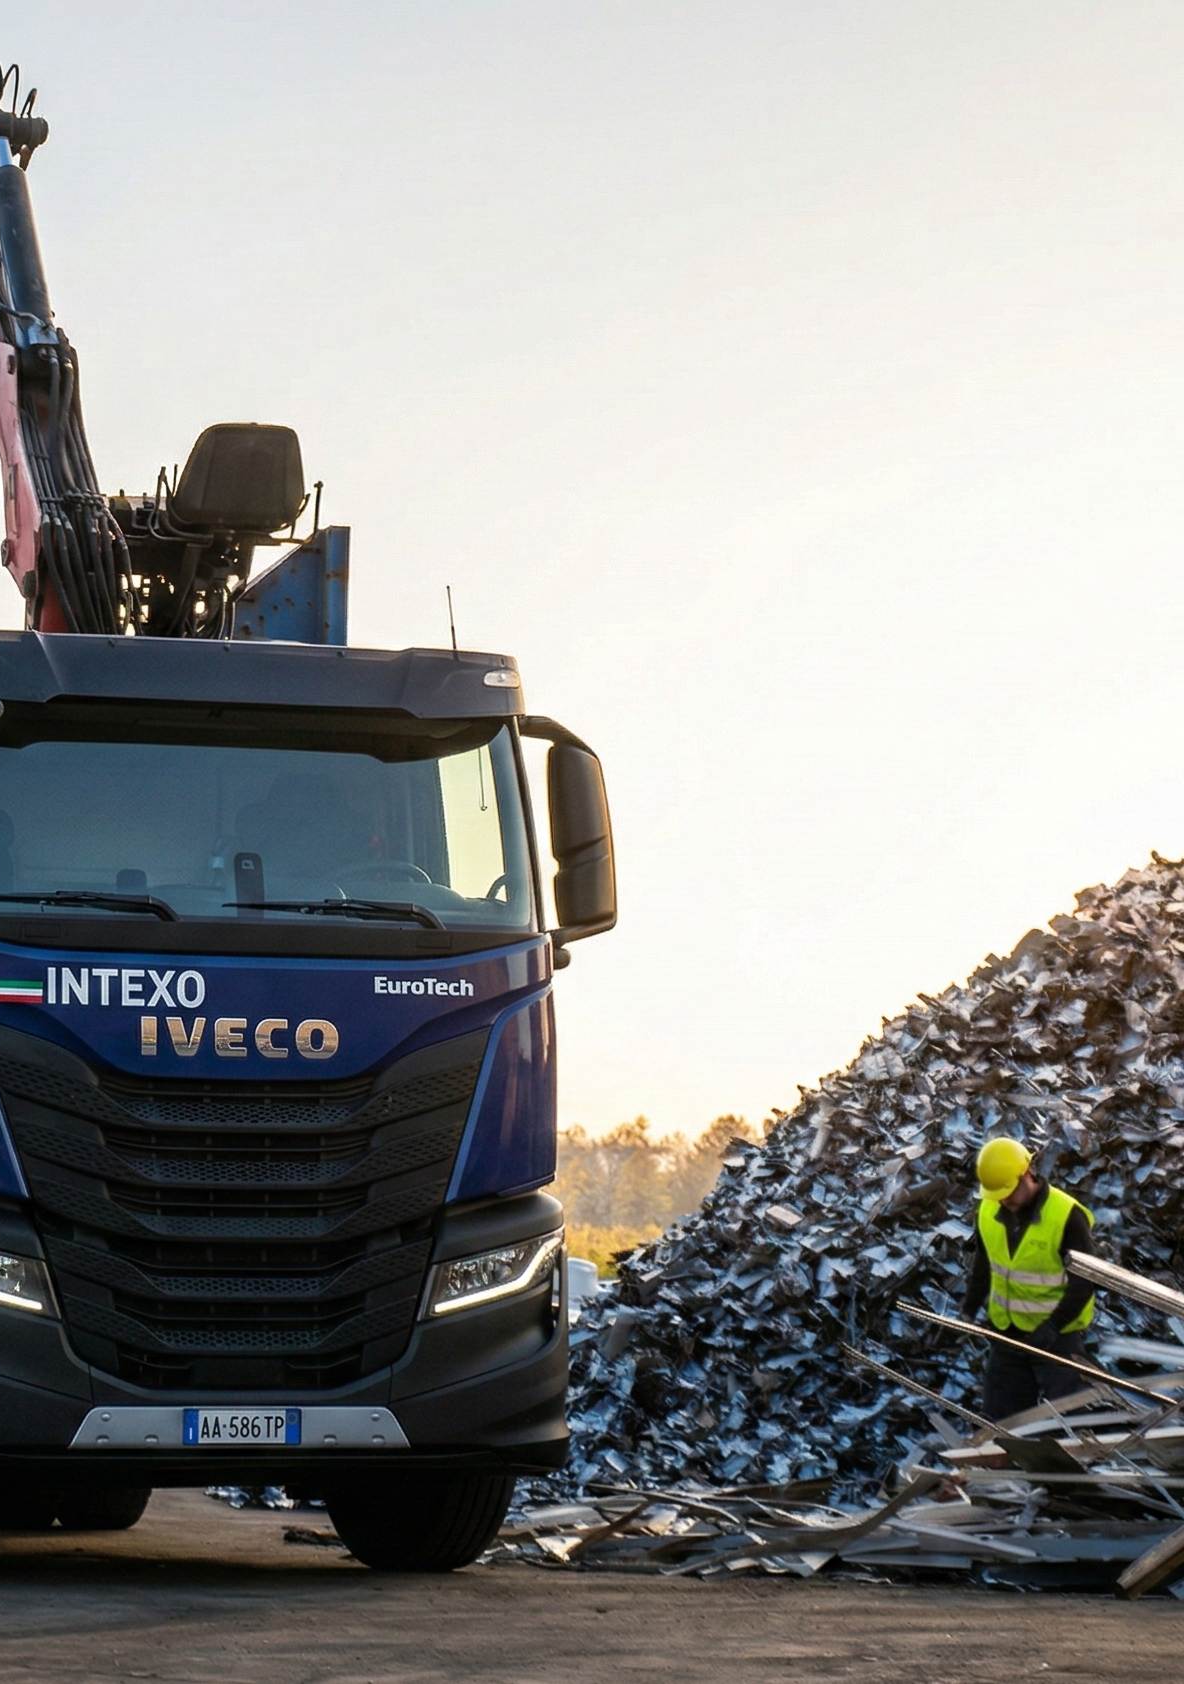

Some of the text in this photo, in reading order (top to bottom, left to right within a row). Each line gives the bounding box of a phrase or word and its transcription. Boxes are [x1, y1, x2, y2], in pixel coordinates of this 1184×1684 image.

[47, 966, 206, 1009] INTEXO
[374, 975, 475, 998] EuroTech
[140, 1015, 339, 1060] IVECO
